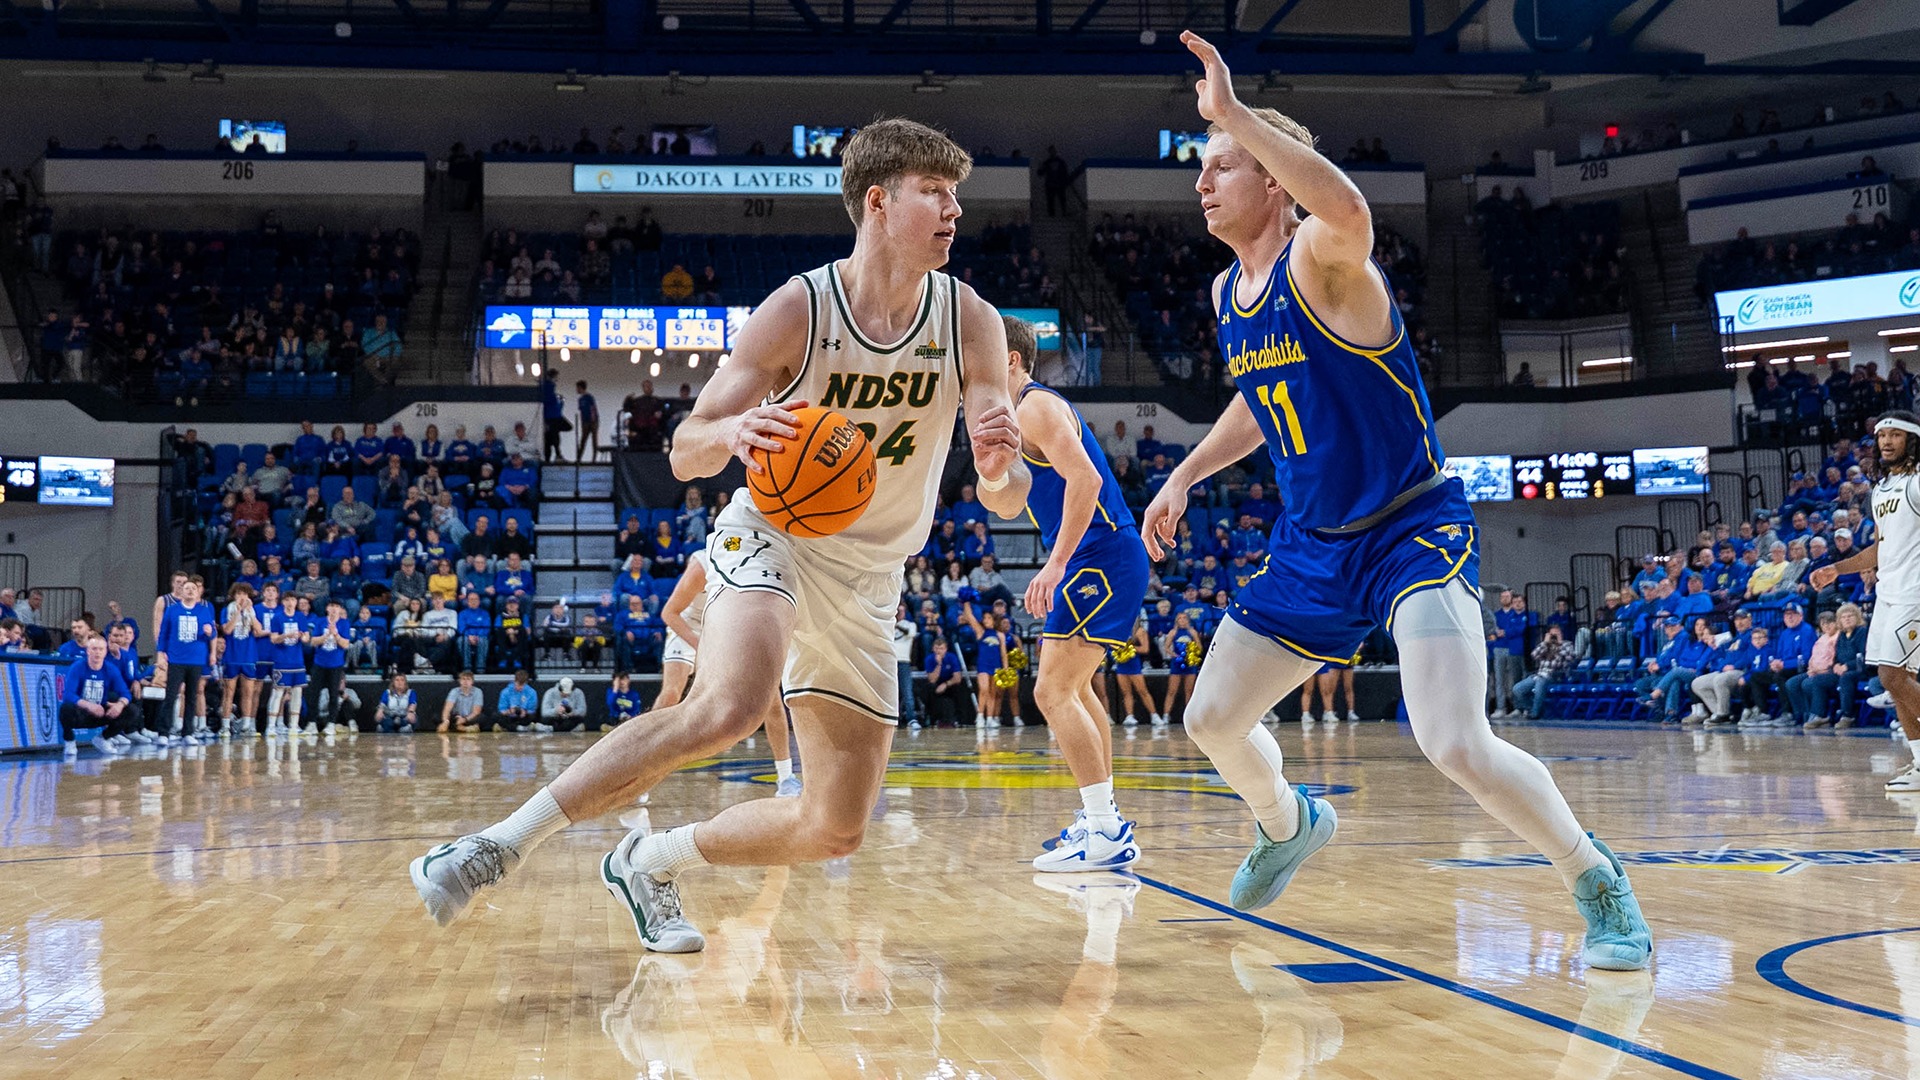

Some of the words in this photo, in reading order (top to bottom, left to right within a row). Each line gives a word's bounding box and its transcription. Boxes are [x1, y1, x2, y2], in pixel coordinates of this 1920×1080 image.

[223, 161, 254, 180] 206
[1580, 161, 1608, 180] 209
[636, 171, 722, 187] DAKOTA
[733, 171, 814, 188] LAYERS
[1852, 186, 1887, 209] 210
[744, 198, 774, 217] 207
[1763, 301, 1812, 313] SOYBEAN
[605, 335, 651, 346] 50.0%
[673, 335, 718, 346] 37.5%
[819, 371, 940, 410] NDSU
[416, 403, 438, 417] 206
[1136, 403, 1157, 417] 208
[1256, 380, 1307, 458] 11
[1548, 452, 1599, 469] 14:06
[1516, 467, 1544, 484] 44
